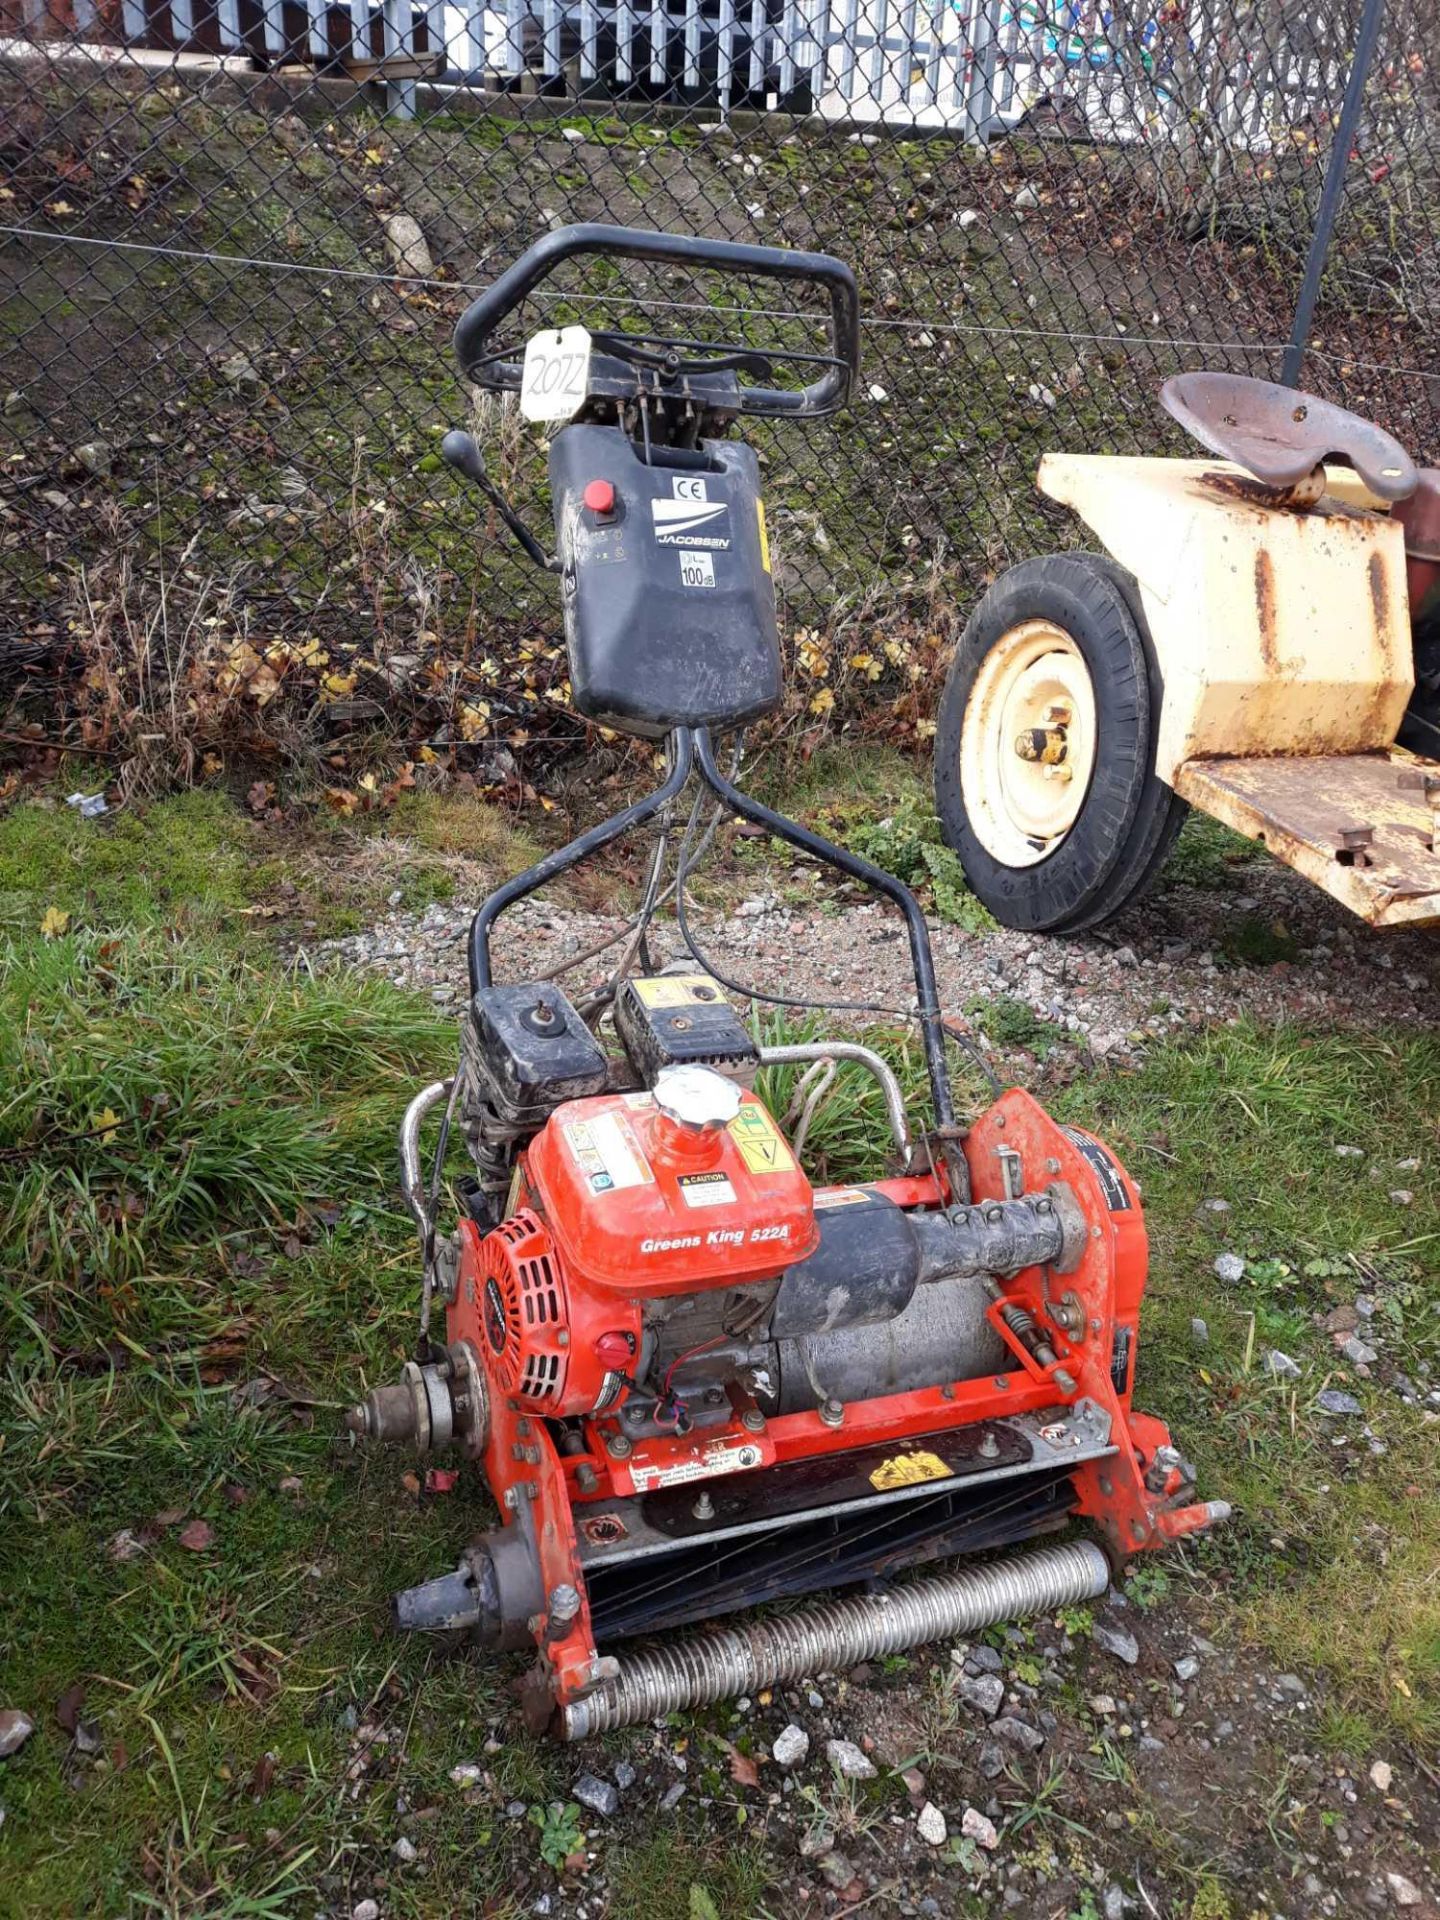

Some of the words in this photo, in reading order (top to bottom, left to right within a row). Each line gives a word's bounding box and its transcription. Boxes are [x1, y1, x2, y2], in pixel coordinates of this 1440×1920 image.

[677, 480, 702, 500] CE
[658, 535, 730, 548] JACOBSEN
[682, 566, 703, 586] 100
[704, 575, 714, 586] dB
[690, 1173, 725, 1184] CAUTION
[640, 1235, 702, 1253] Greens
[706, 1230, 745, 1247] King
[750, 1225, 790, 1242] 522A
